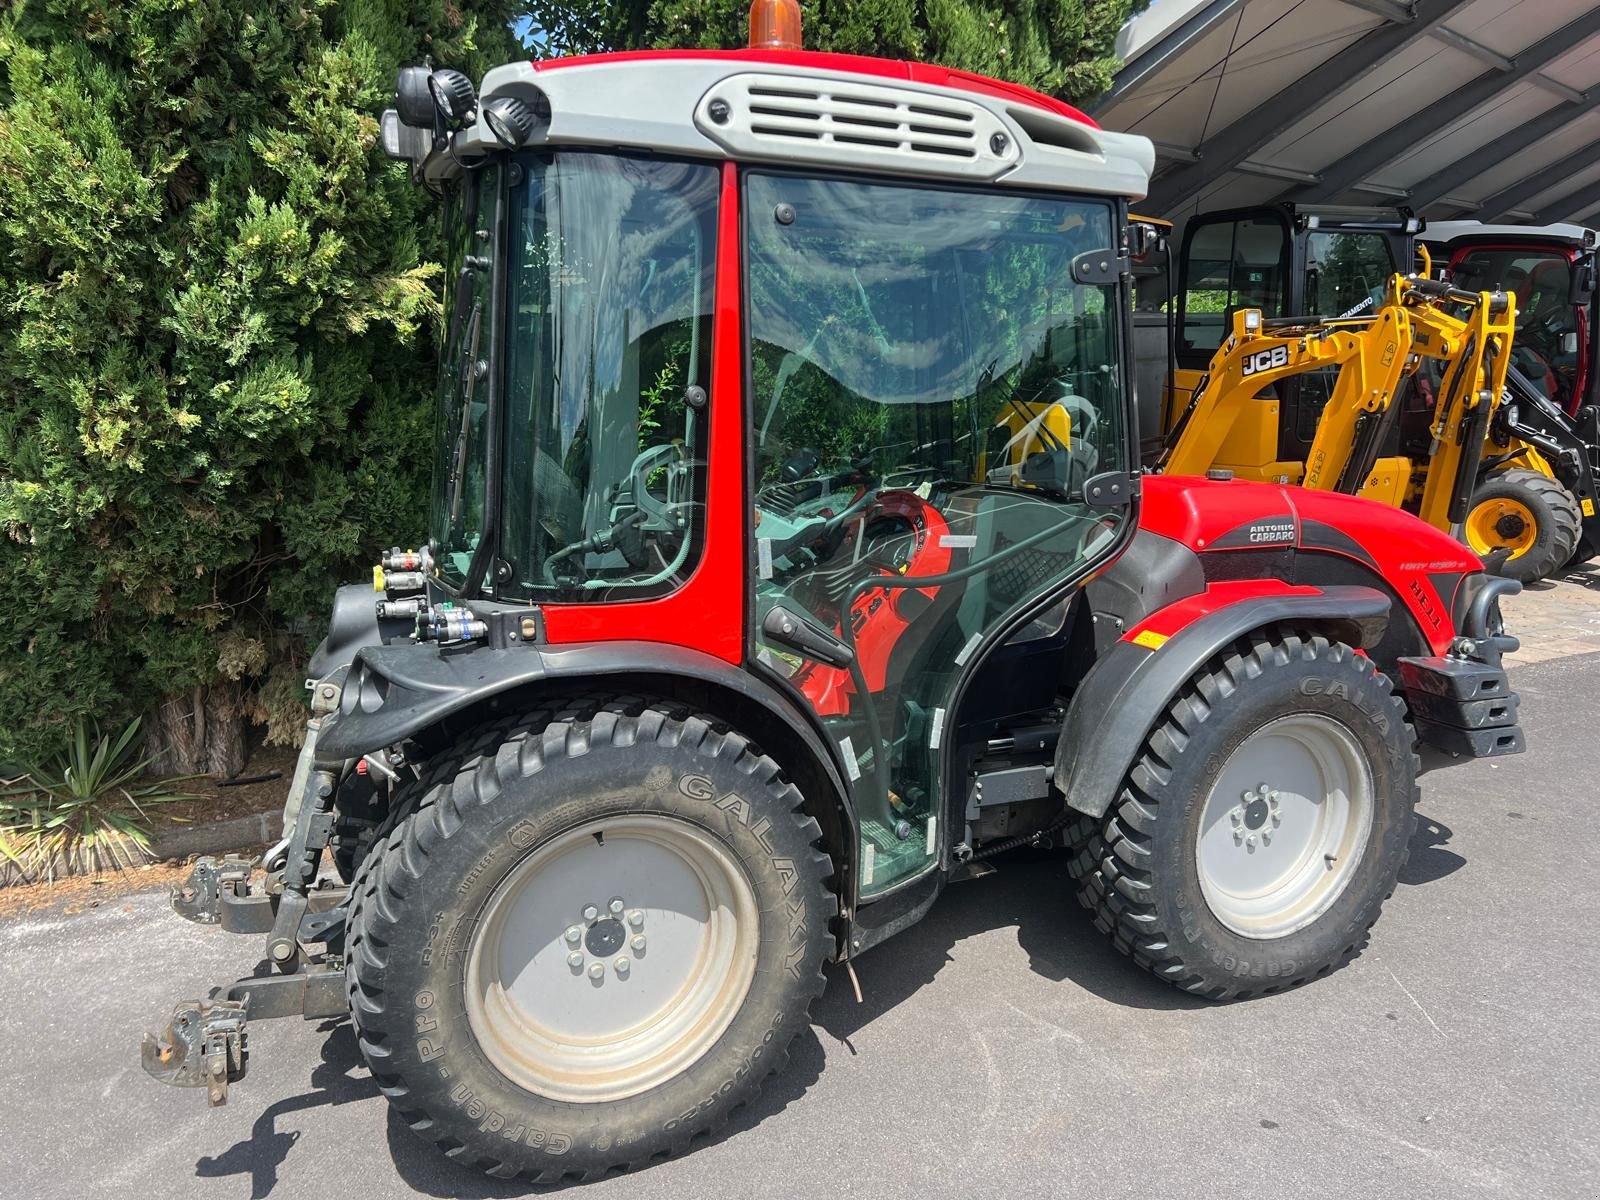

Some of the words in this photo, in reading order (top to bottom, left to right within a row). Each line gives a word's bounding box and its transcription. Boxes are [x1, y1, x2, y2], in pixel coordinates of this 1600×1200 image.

[1243, 346, 1288, 375] JCB
[1250, 524, 1294, 533] ANTONIO
[1250, 532, 1294, 542] CARRARO
[1410, 580, 1441, 631] HELL
[459, 851, 496, 896] TUBELESS
[678, 774, 808, 981] GALAXY
[422, 911, 445, 968] R-3+
